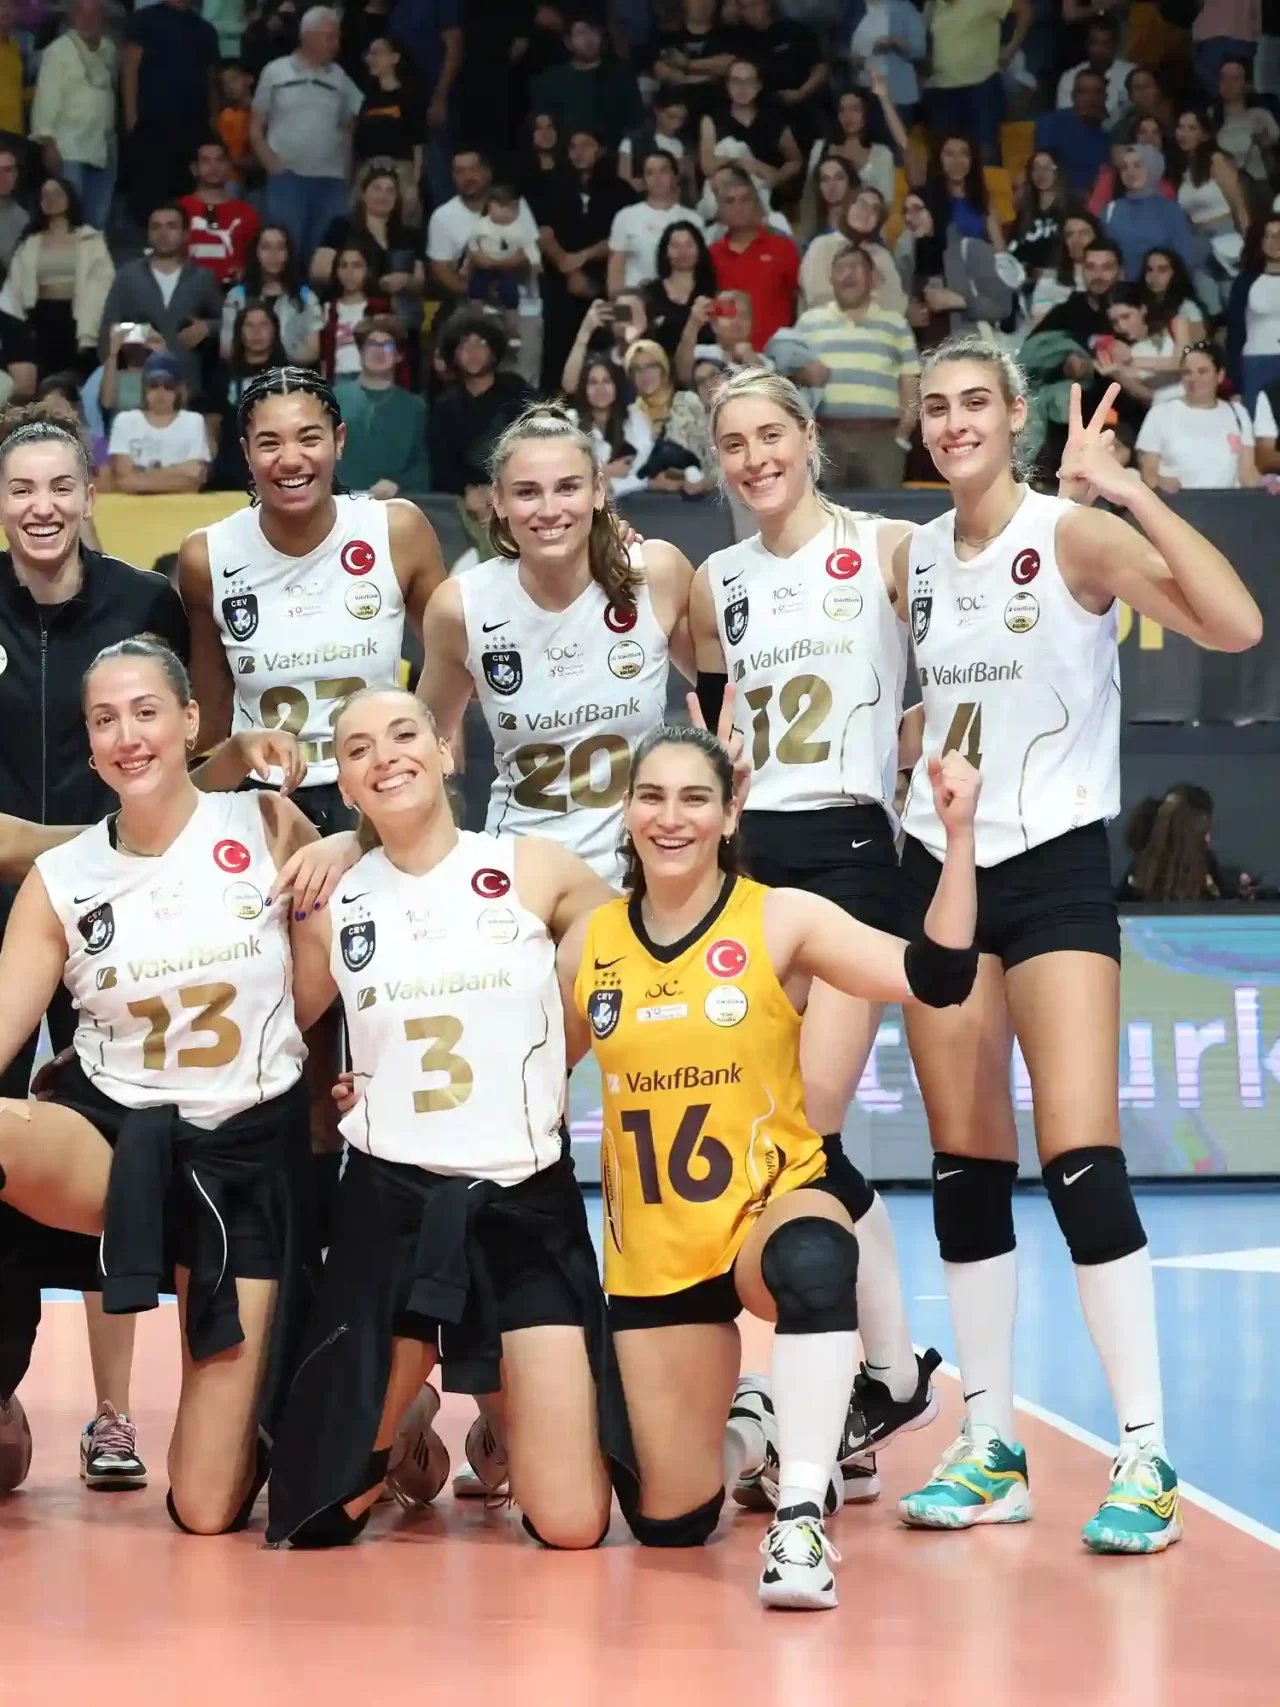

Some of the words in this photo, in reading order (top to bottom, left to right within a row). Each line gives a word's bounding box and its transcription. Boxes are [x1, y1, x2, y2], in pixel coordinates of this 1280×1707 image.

[231, 598, 248, 608] CEV
[492, 654, 510, 662] CEV
[750, 638, 854, 671] VakıfBank
[932, 659, 1024, 686] VakıfBank
[525, 697, 641, 731] VakıfBank
[743, 674, 833, 771] 12
[941, 701, 983, 773] 4
[513, 734, 632, 813] 20
[349, 925, 367, 936] CEV
[597, 992, 614, 1001] CEV
[126, 981, 242, 1071] 13
[404, 1014, 474, 1114] 3
[626, 1062, 743, 1093] VakıfBank
[620, 1103, 734, 1205] 16
